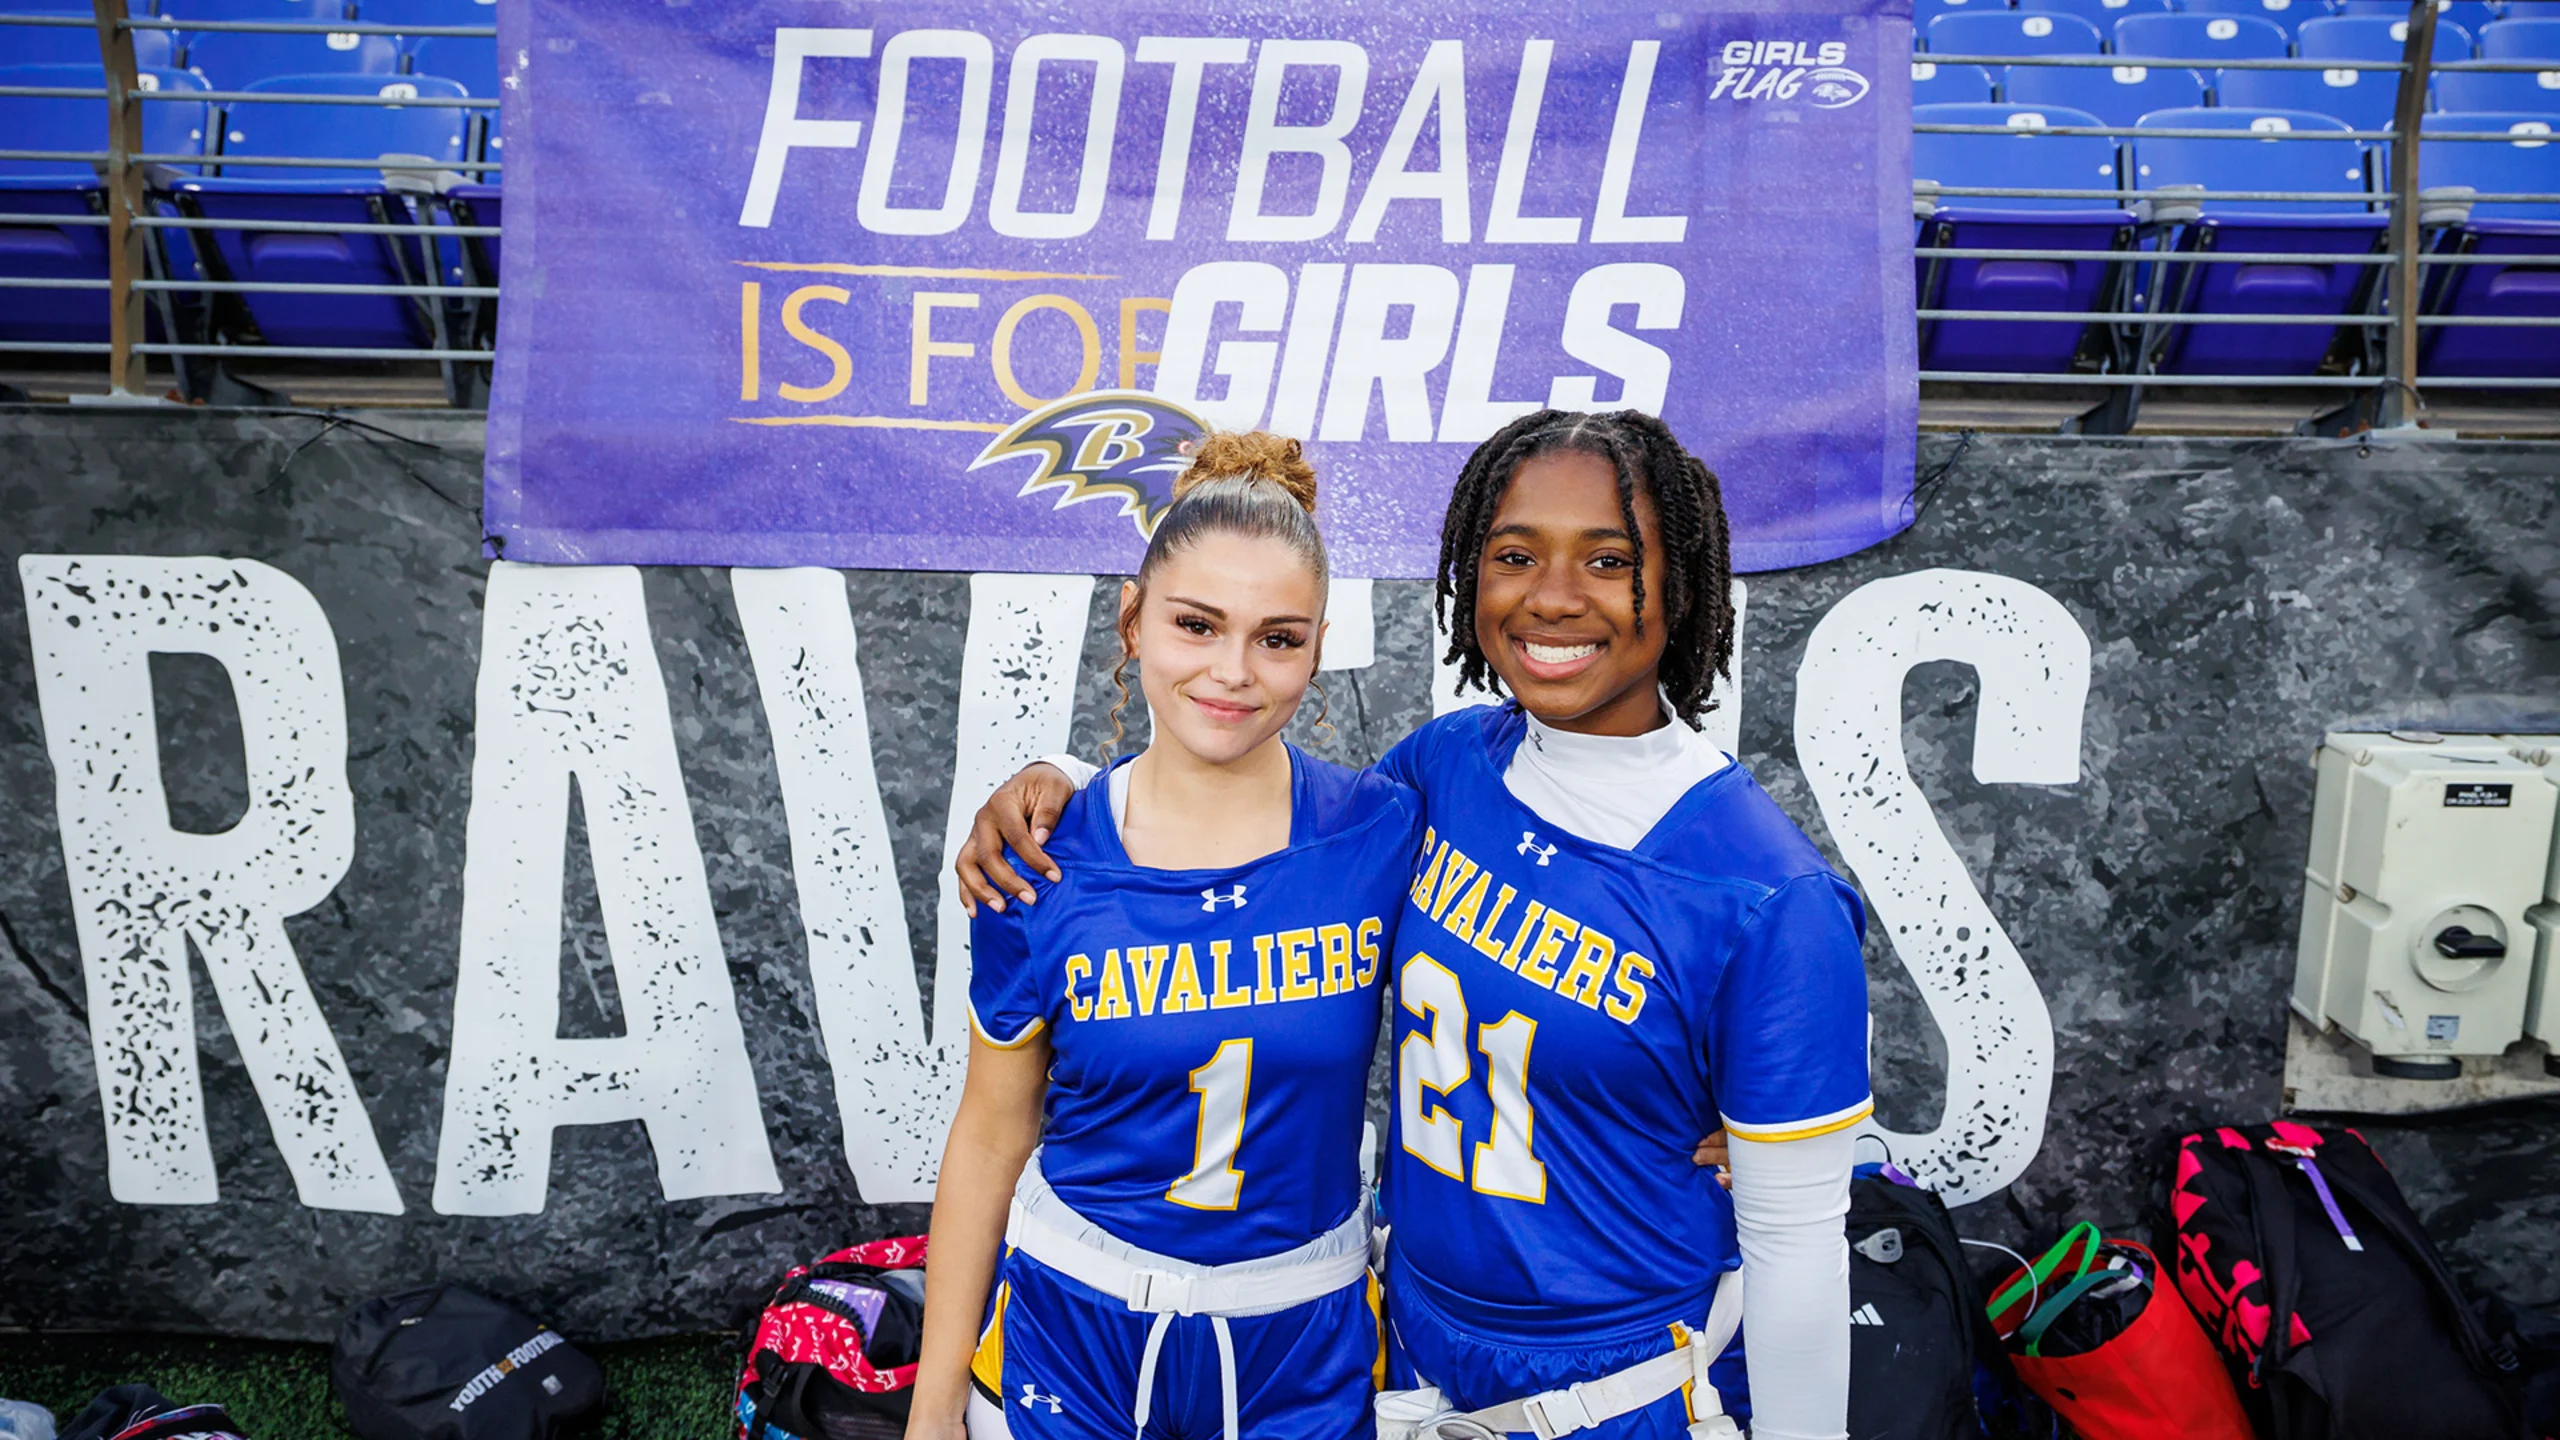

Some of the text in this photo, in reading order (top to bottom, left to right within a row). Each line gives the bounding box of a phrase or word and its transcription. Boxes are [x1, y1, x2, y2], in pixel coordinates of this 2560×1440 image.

[739, 27, 1688, 243] FOOTBALL
[1709, 67, 1806, 100] FLAG
[1722, 41, 1847, 65] GIRLS
[741, 282, 853, 403] IS
[1152, 261, 1686, 442] GIRLS
[18, 554, 2091, 1216] RAVS
[1065, 916, 1383, 1022] CAVALIERS
[1164, 1037, 1254, 1211] 1
[1400, 951, 1547, 1205] 21
[449, 1363, 506, 1413] YOUTH
